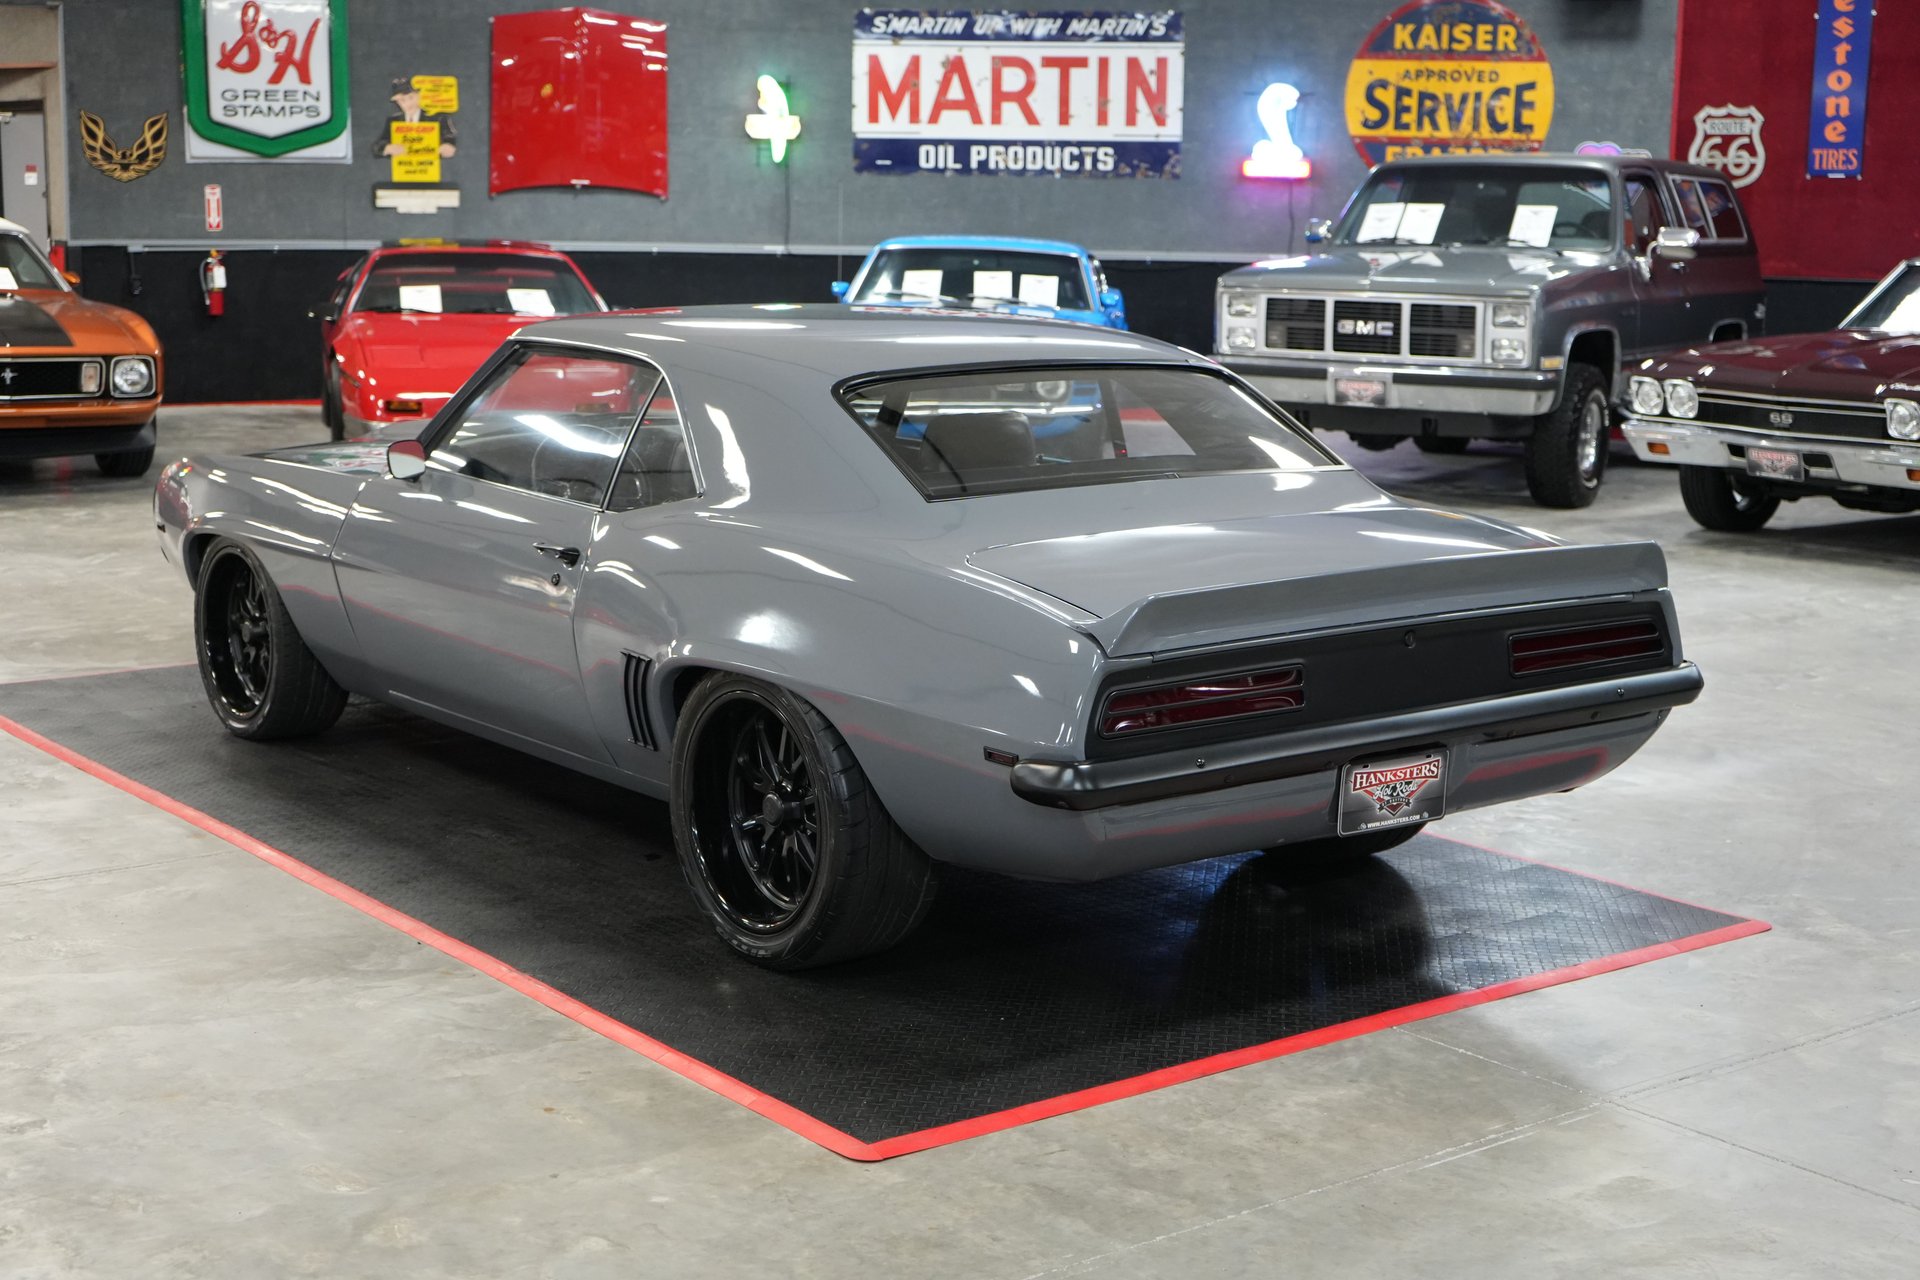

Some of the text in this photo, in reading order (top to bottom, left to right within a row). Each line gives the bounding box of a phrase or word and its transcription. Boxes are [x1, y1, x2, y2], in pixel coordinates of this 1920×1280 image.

[973, 17, 1001, 35] UP
[1010, 19, 1060, 35] WITH
[1066, 18, 1168, 36] MARTIN'S
[1394, 24, 1518, 51] KAISER
[216, 1, 321, 85] S&H
[1402, 69, 1500, 83] APPROVED
[221, 89, 321, 102] GREEN
[868, 54, 1169, 128] MARTIN
[222, 105, 321, 118] STAMPS
[1361, 78, 1537, 134] SERVICE
[1709, 121, 1748, 134] ROUTE
[918, 144, 1116, 172] OIL PRODUCTS
[1700, 137, 1752, 177] 66
[1812, 148, 1859, 171] TIRES
[1337, 319, 1394, 336] GMC
[1354, 761, 1439, 790] HANKSTERS
[1372, 781, 1418, 800] Hot Rods
